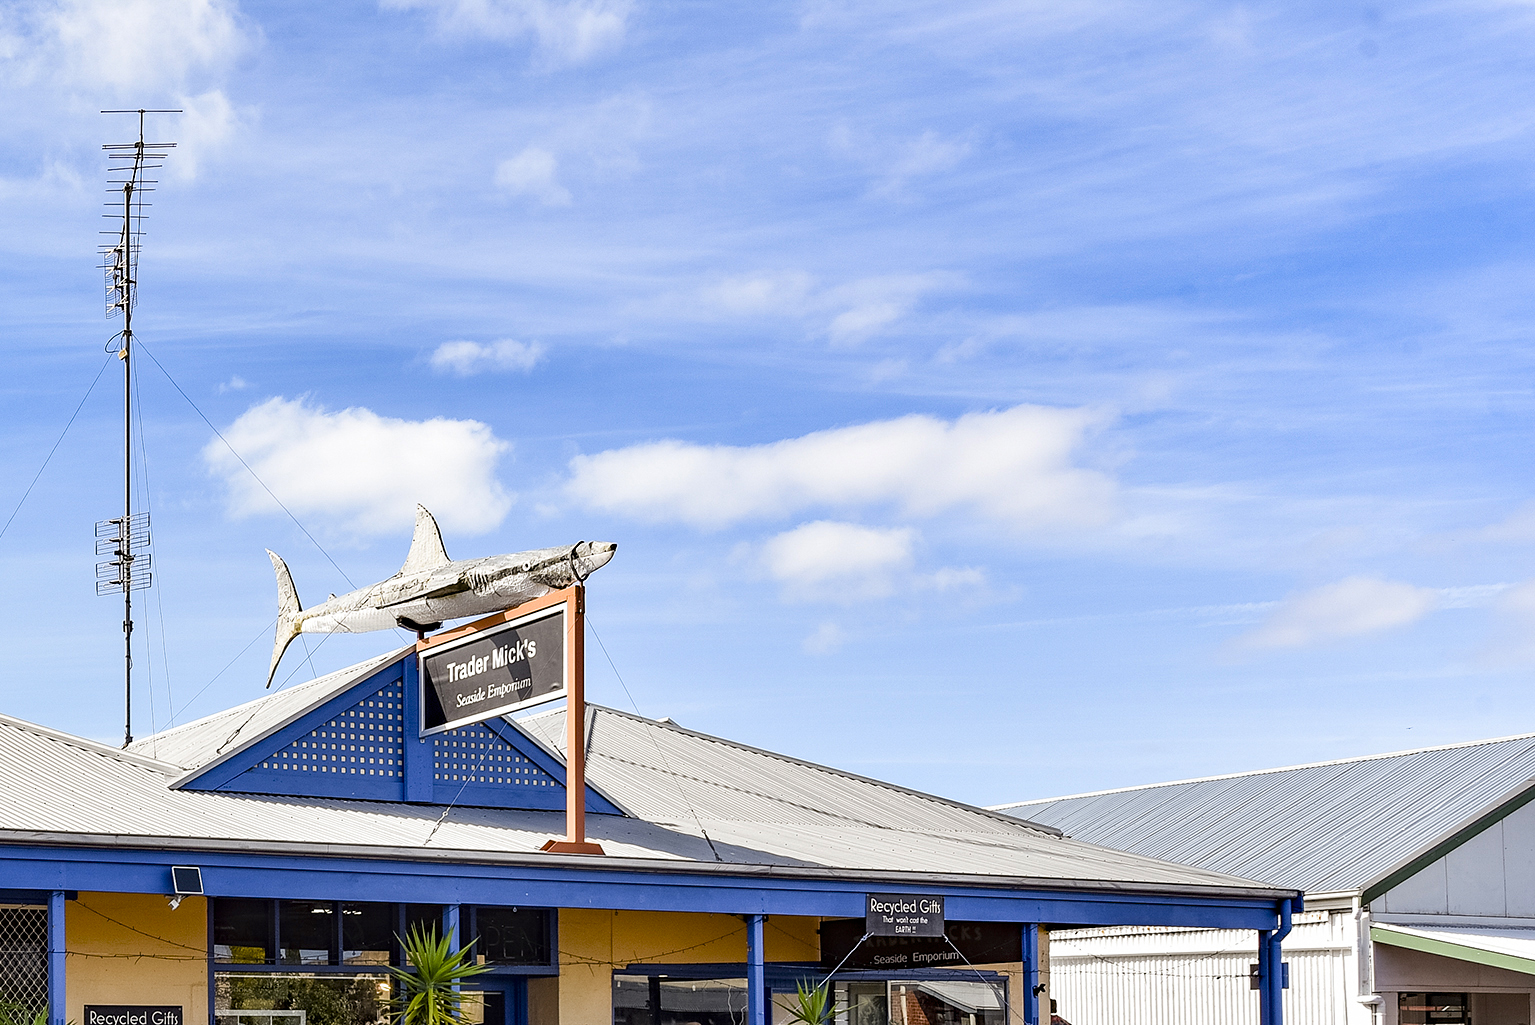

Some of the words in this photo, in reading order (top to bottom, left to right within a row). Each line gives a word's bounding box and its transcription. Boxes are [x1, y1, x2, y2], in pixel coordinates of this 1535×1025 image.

[447, 655, 489, 683] Trader
[492, 638, 537, 670] Mick's
[456, 685, 486, 708] Seaside
[487, 676, 531, 699] Emporium
[870, 897, 917, 915] Recycled
[919, 899, 941, 914] Gifts
[882, 915, 894, 923] That
[896, 916, 909, 924] won't
[909, 916, 919, 924] cost
[919, 916, 928, 924] the
[895, 926, 911, 934] EARTH
[874, 953, 908, 965] Seaside
[913, 951, 960, 964] Emporium
[151, 1010, 179, 1025] Gifts
